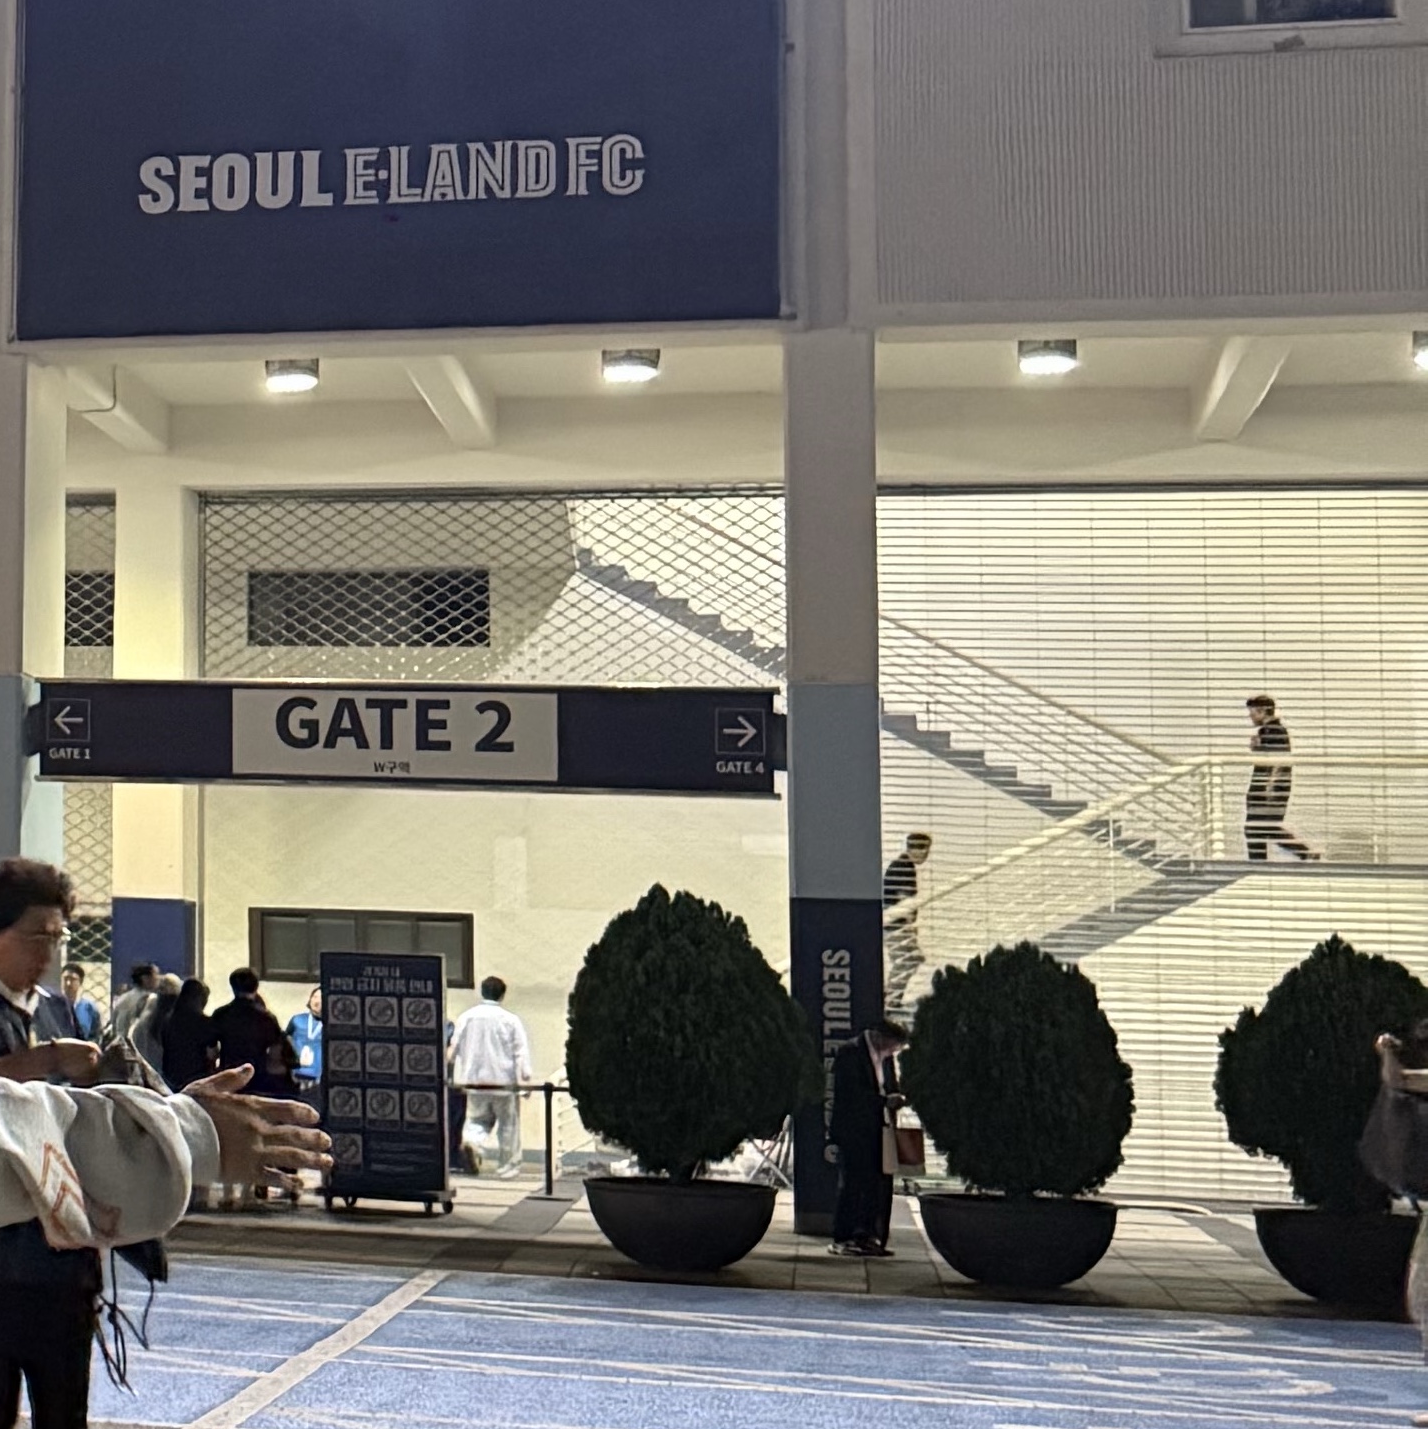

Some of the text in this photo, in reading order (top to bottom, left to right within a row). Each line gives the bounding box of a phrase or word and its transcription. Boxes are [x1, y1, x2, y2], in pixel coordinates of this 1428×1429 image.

[139, 153, 332, 214] SEOUL
[566, 135, 645, 196] FC
[274, 696, 515, 753] GATE 2
[49, 747, 91, 760] GATE 1
[715, 760, 765, 775] GATE 4
[821, 949, 852, 1038] SEOUL
